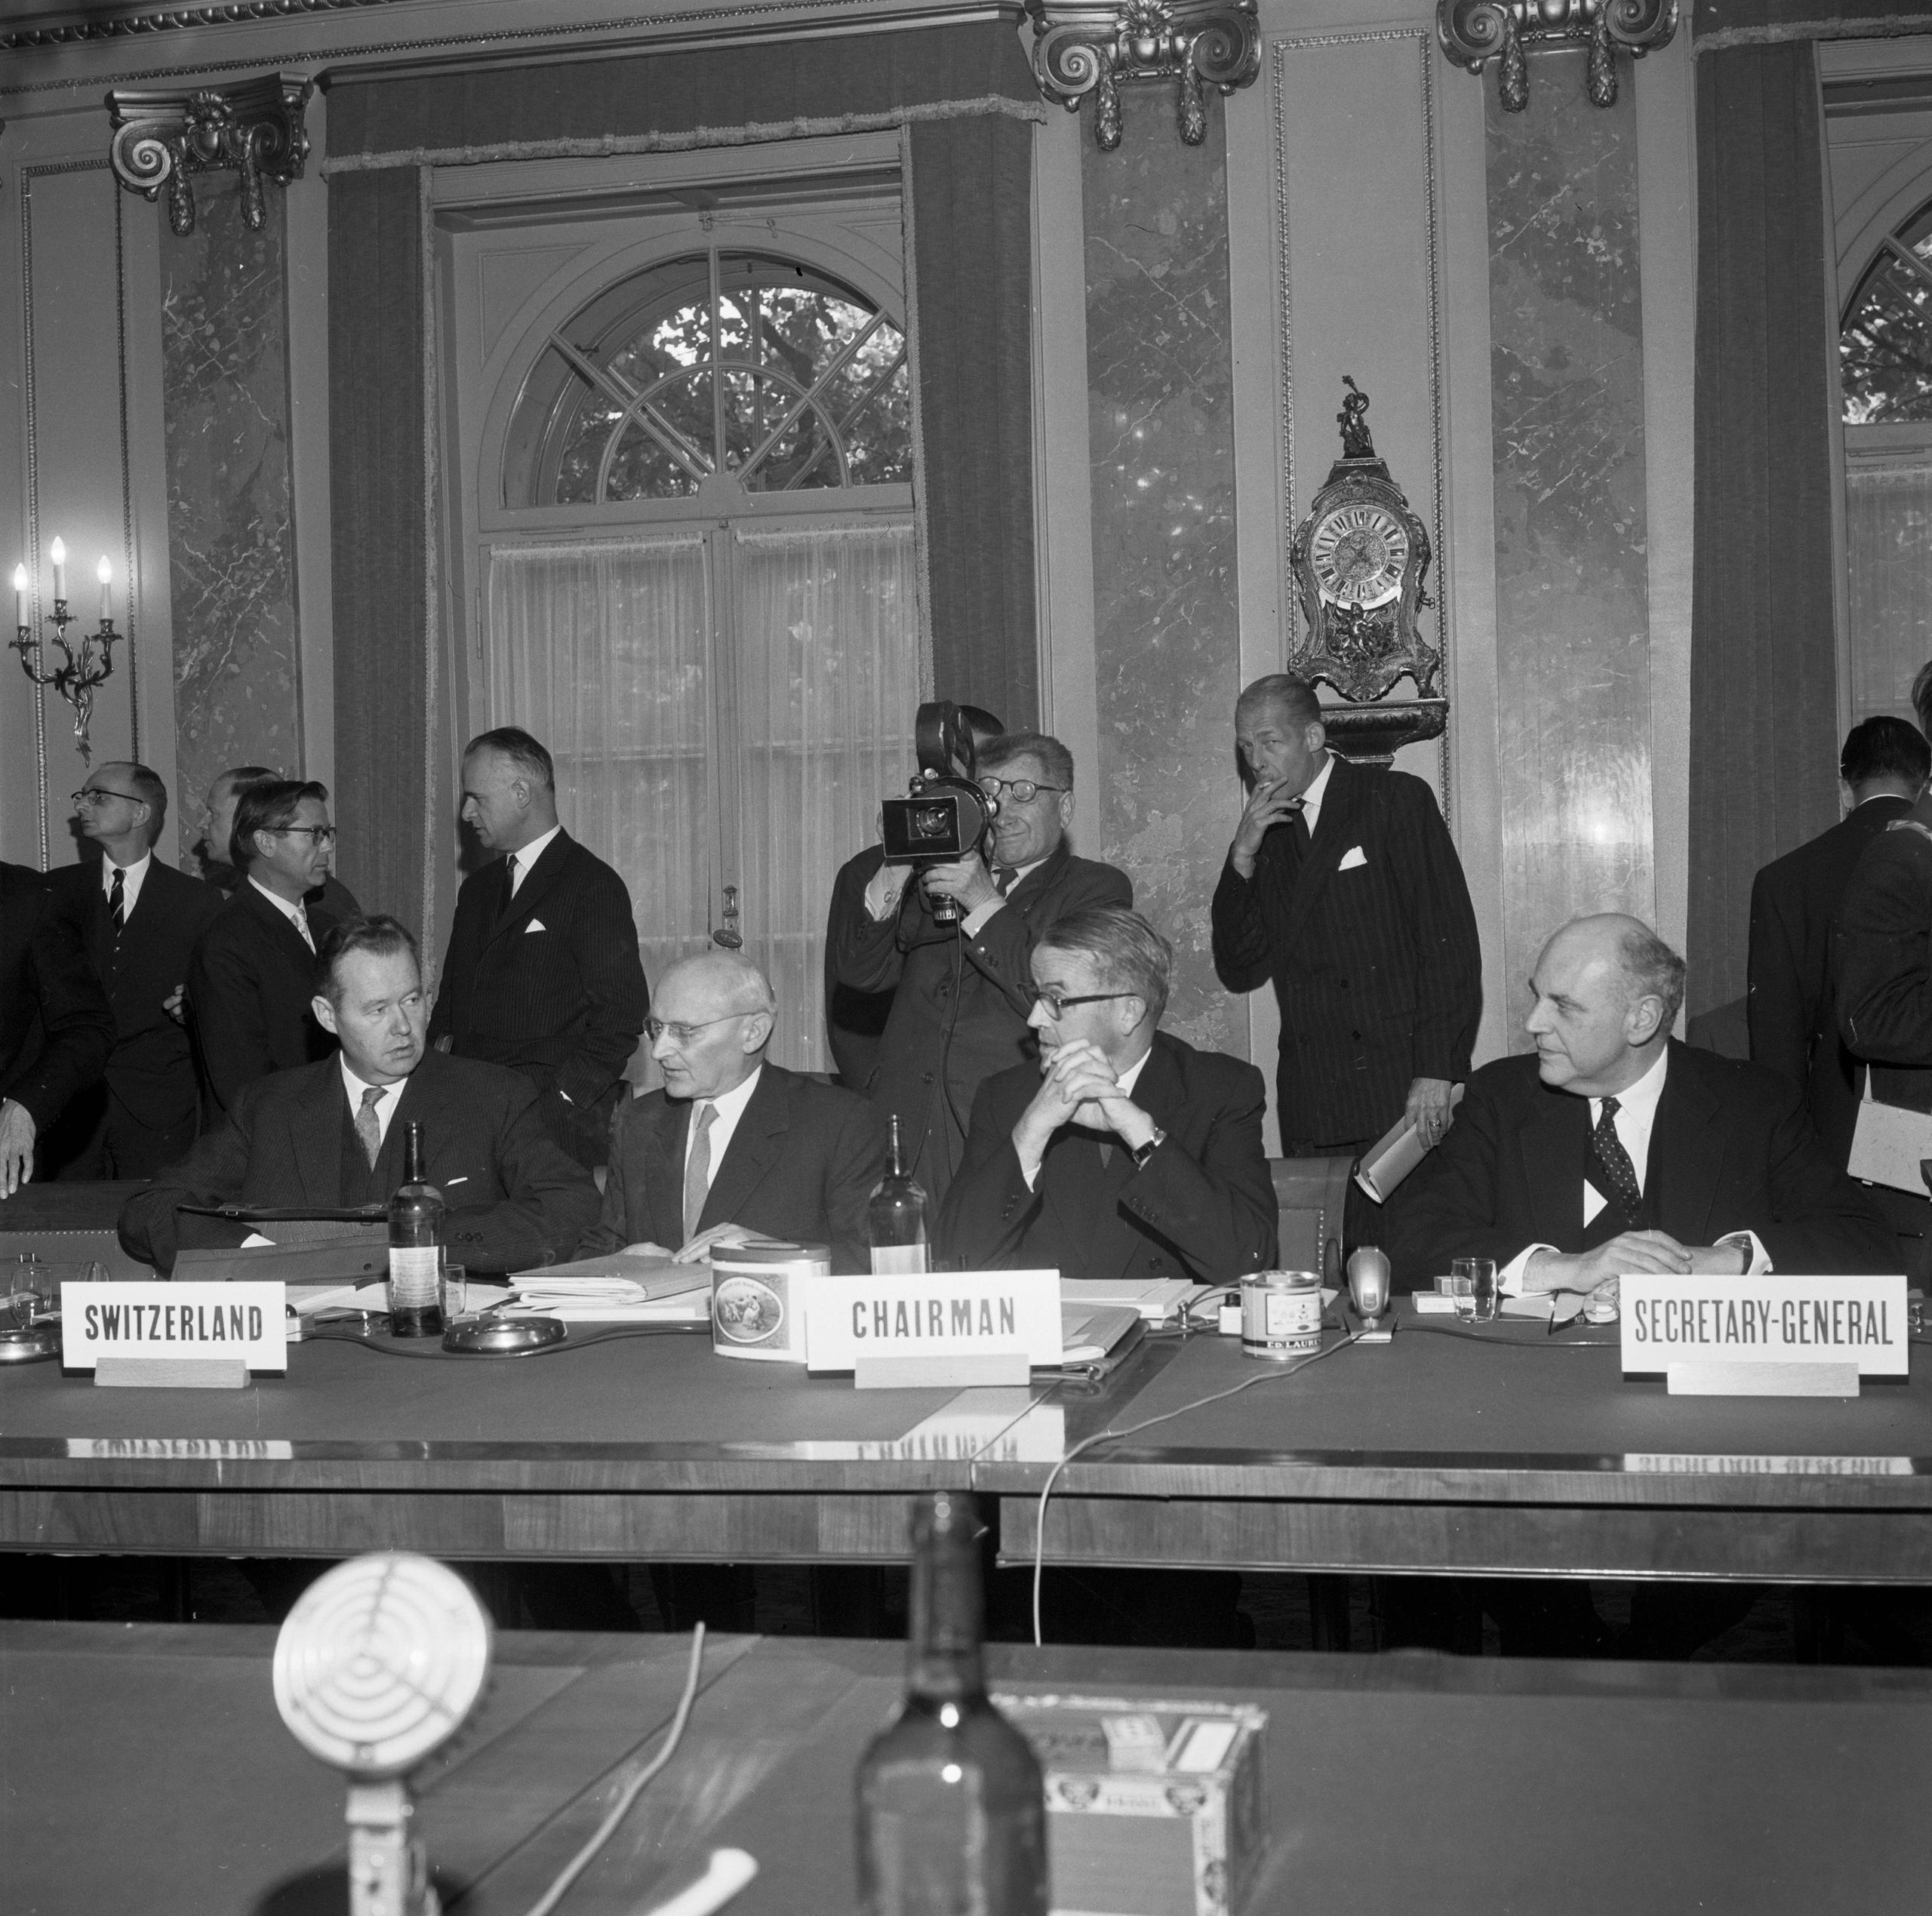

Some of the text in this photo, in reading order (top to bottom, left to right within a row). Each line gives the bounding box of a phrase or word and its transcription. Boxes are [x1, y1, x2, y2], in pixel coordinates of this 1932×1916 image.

[86, 1306, 261, 1340] SWITZERLAND
[854, 1297, 1015, 1338] CHAIRMAN
[1636, 1300, 1893, 1344] SECRETARY-GENERAL
